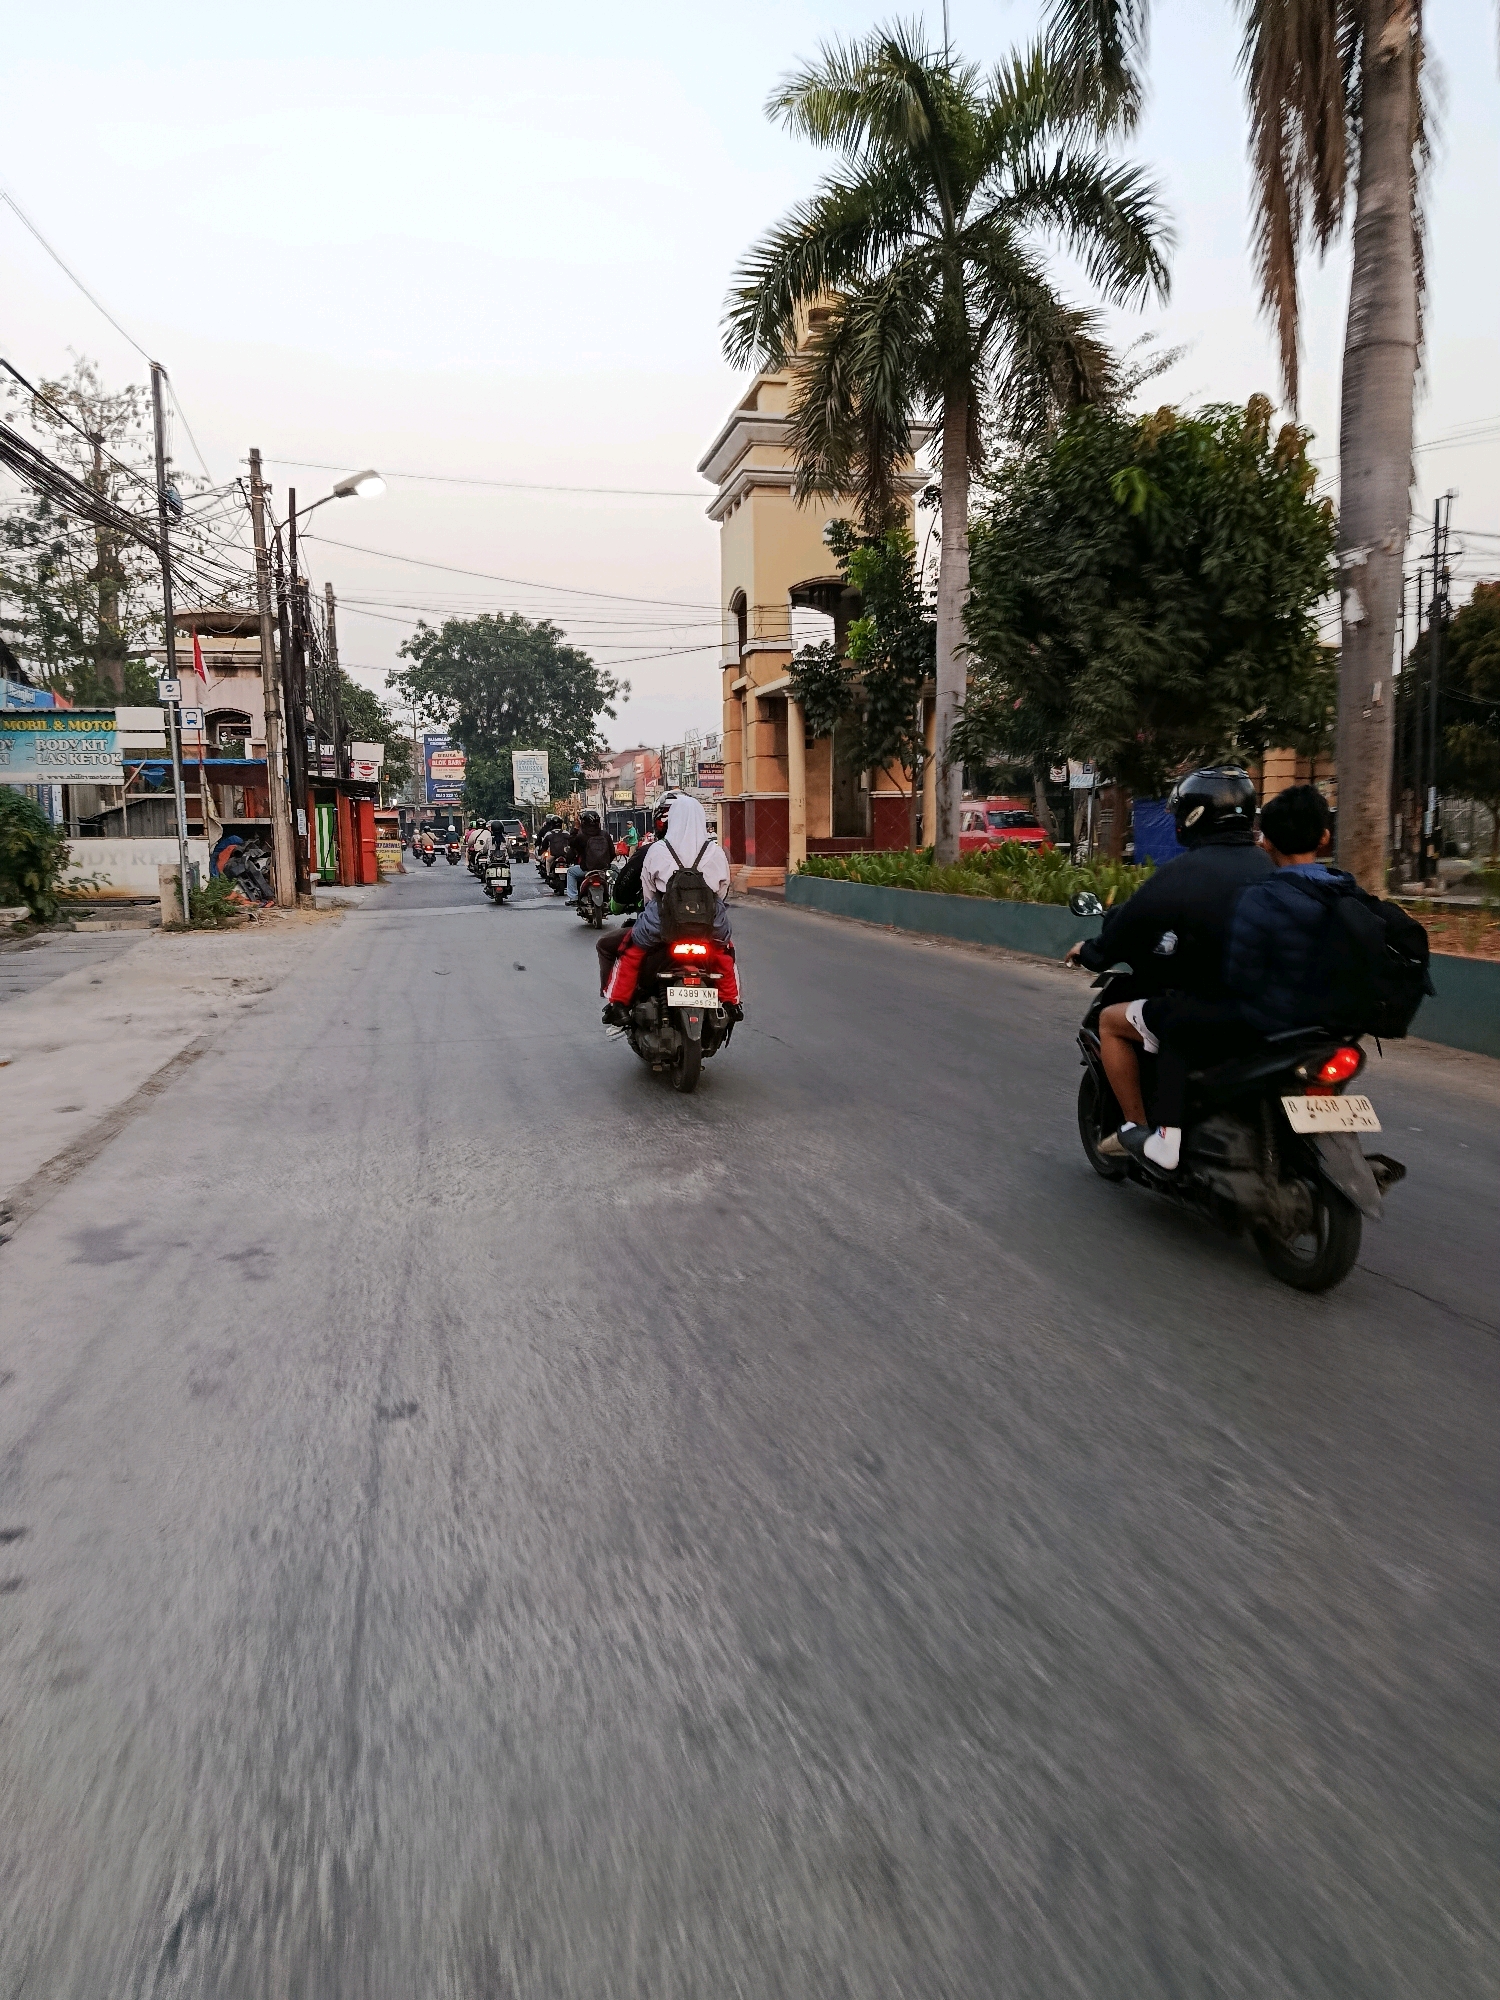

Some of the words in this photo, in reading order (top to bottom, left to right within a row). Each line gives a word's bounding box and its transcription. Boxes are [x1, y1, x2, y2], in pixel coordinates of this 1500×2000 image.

[3, 720, 51, 732] MOBIL
[53, 720, 65, 732] &
[35, 739, 79, 751] BODY
[82, 739, 108, 751] KIT
[36, 753, 67, 765] LAS
[68, 753, 122, 766] KETOK
[669, 989, 675, 997] B
[678, 989, 699, 998] 4389
